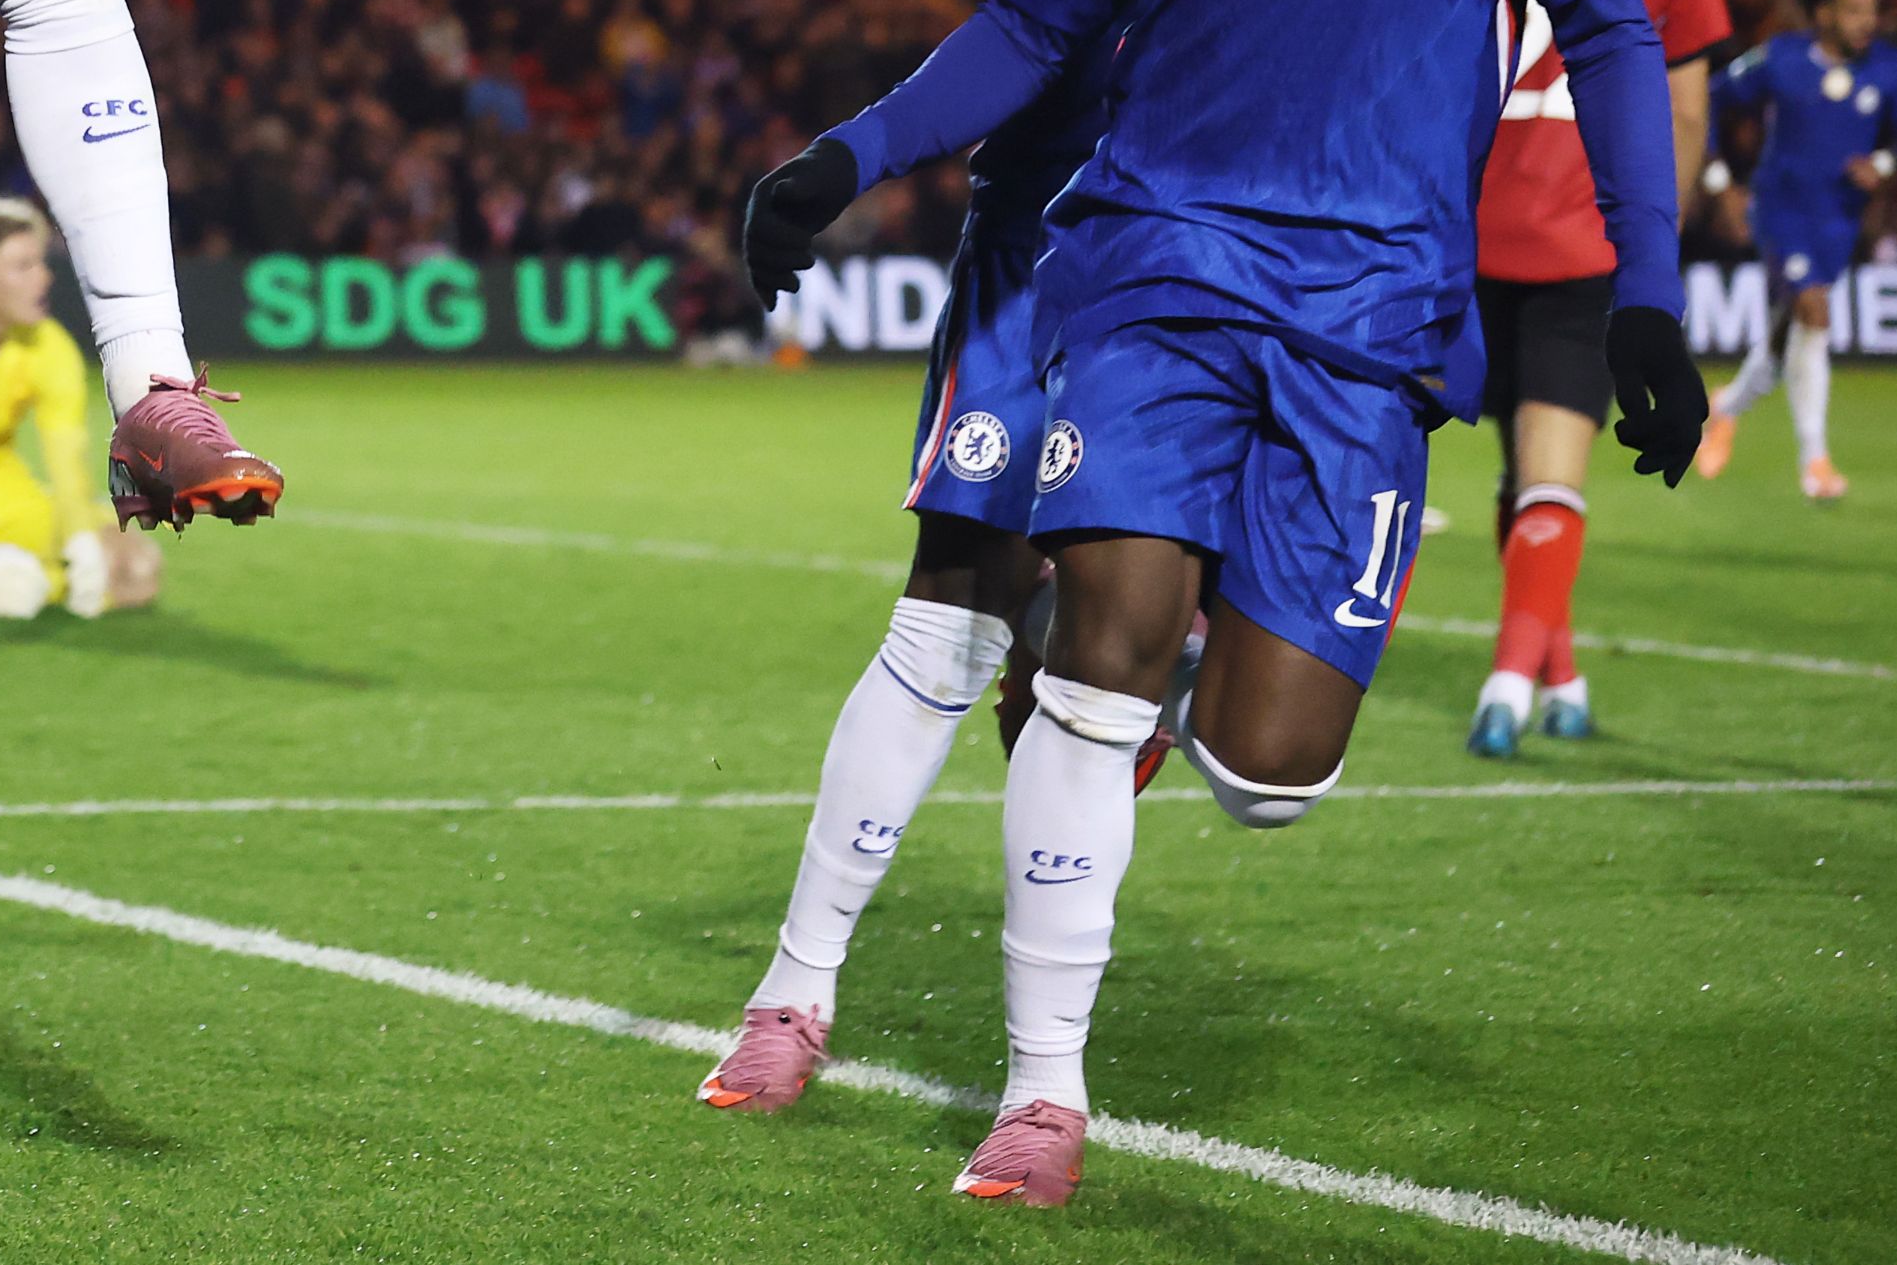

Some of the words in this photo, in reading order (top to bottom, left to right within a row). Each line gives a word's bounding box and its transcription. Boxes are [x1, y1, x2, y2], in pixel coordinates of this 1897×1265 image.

[81, 99, 148, 117] CFC
[244, 251, 488, 350] SDG
[514, 254, 677, 351] UK
[764, 254, 954, 352] ND
[1352, 489, 1412, 610] 11
[1030, 850, 1093, 870] CFC
